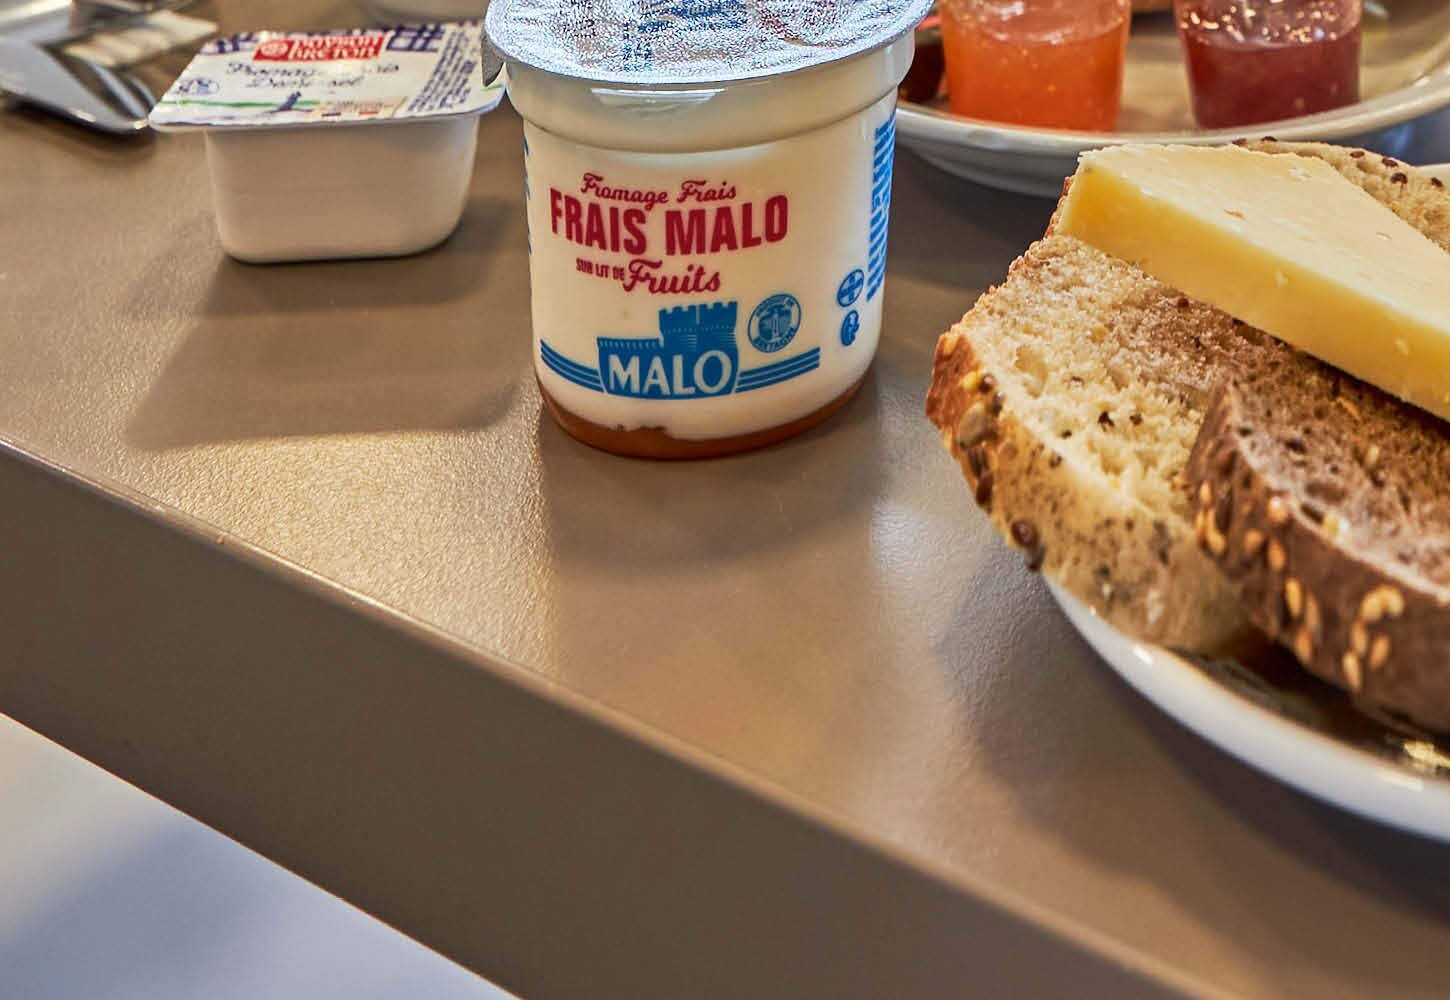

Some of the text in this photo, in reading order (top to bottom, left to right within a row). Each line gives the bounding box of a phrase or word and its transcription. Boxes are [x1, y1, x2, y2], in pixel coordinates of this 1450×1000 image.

[581, 172, 737, 211] Fromage Frais
[550, 187, 648, 255] FRAIS
[665, 194, 789, 256] MALO
[576, 257, 722, 294] SUR LIT DE Fruits
[608, 350, 732, 395] MALO
